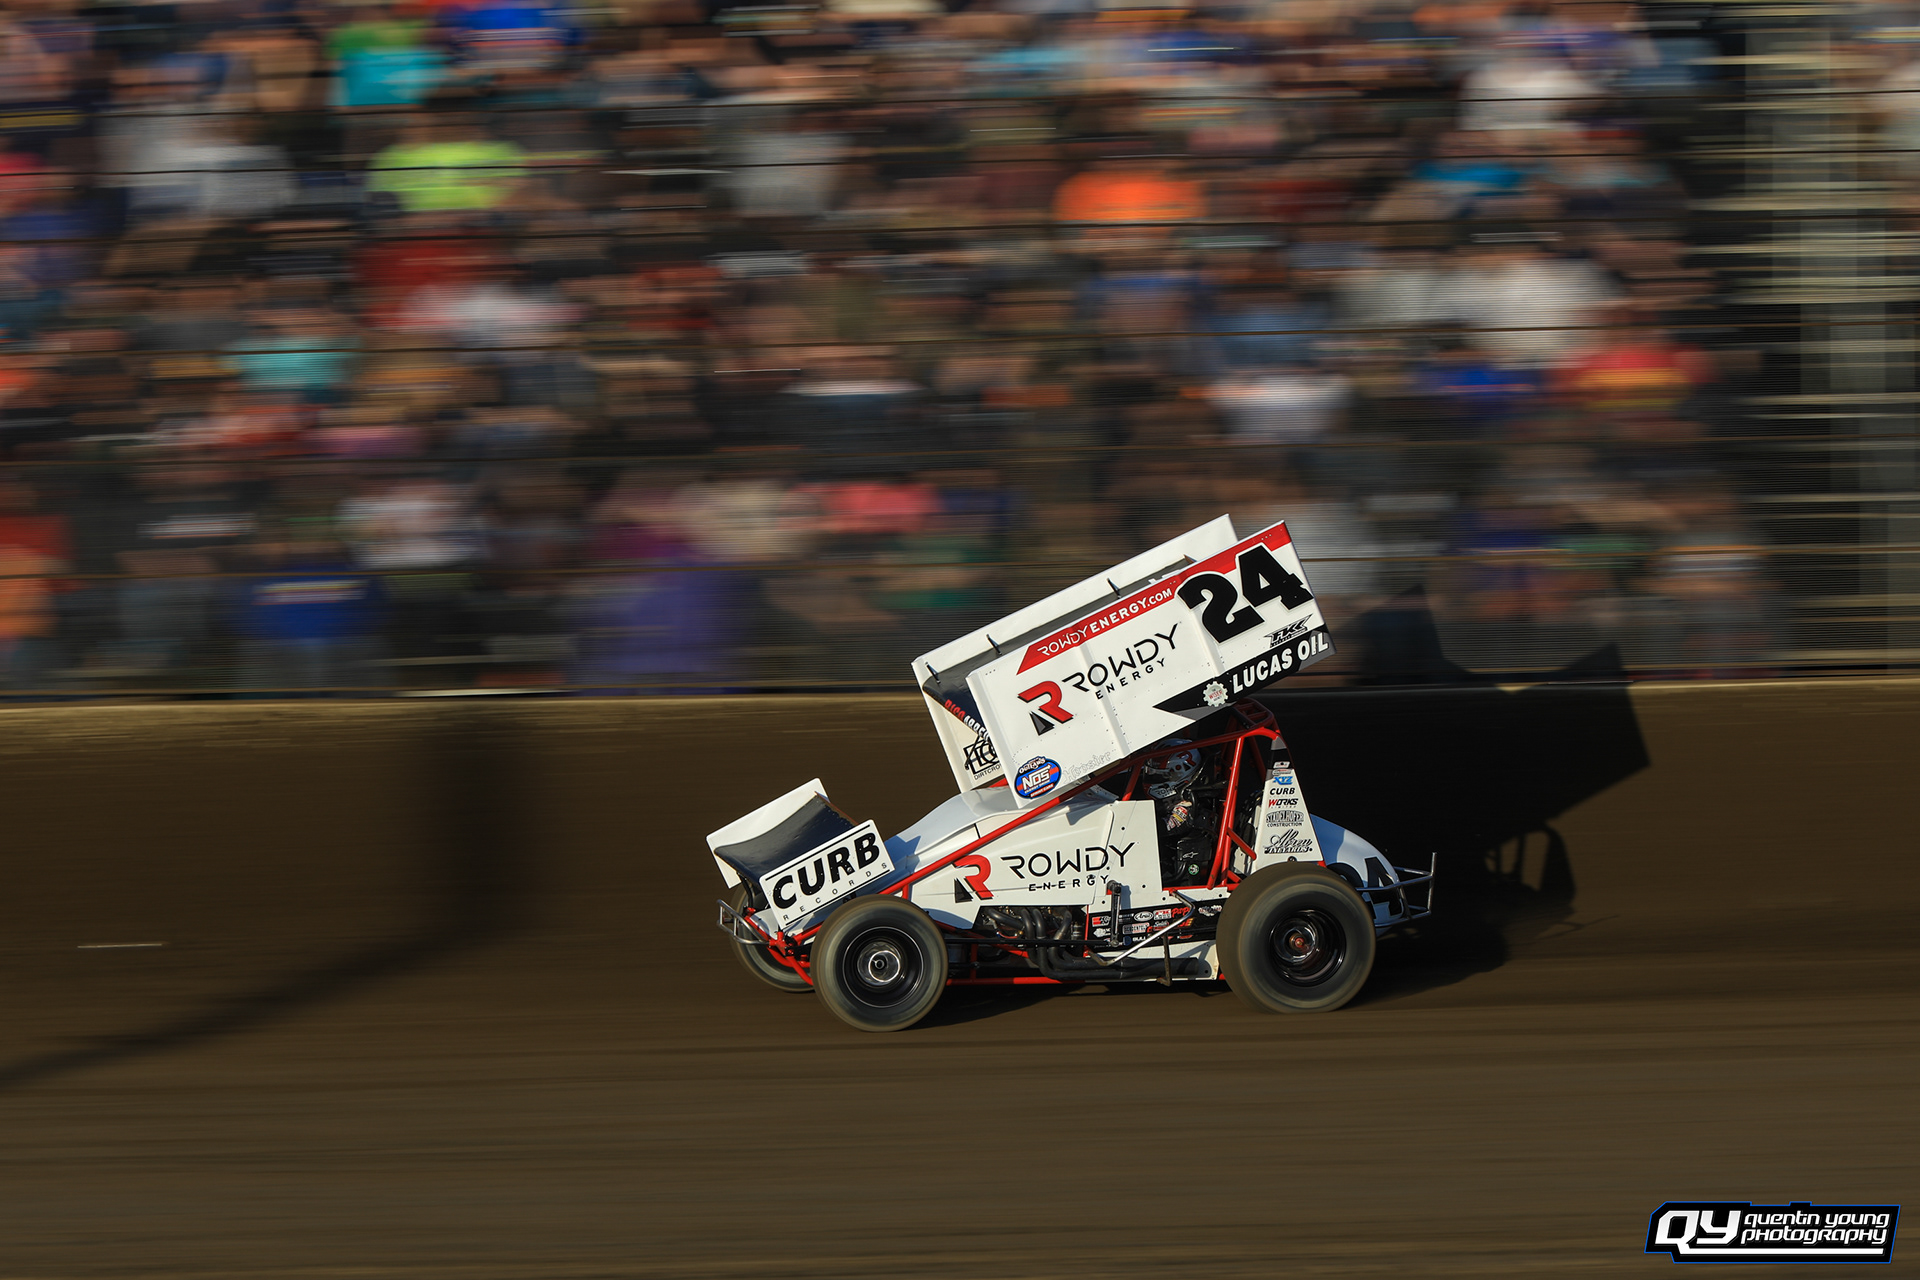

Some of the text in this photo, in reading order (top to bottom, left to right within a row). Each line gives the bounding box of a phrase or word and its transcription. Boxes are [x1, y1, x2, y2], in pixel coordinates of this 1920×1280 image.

[1176, 544, 1314, 644] 24
[1037, 588, 1172, 656] ROWDYENERGY.COM
[1062, 623, 1178, 693] ROWDY
[1095, 658, 1165, 700] ENERGY
[1232, 632, 1329, 694] LUCAS OIL
[1022, 763, 1052, 791] NOS
[1269, 787, 1295, 796] CURB
[1272, 775, 1293, 785] XYZ
[1268, 799, 1298, 808] WORKS
[772, 832, 880, 910] CURB
[1000, 842, 1135, 880] ROWDY
[783, 863, 887, 921] RECORDS
[1028, 875, 1110, 892] ENERGY
